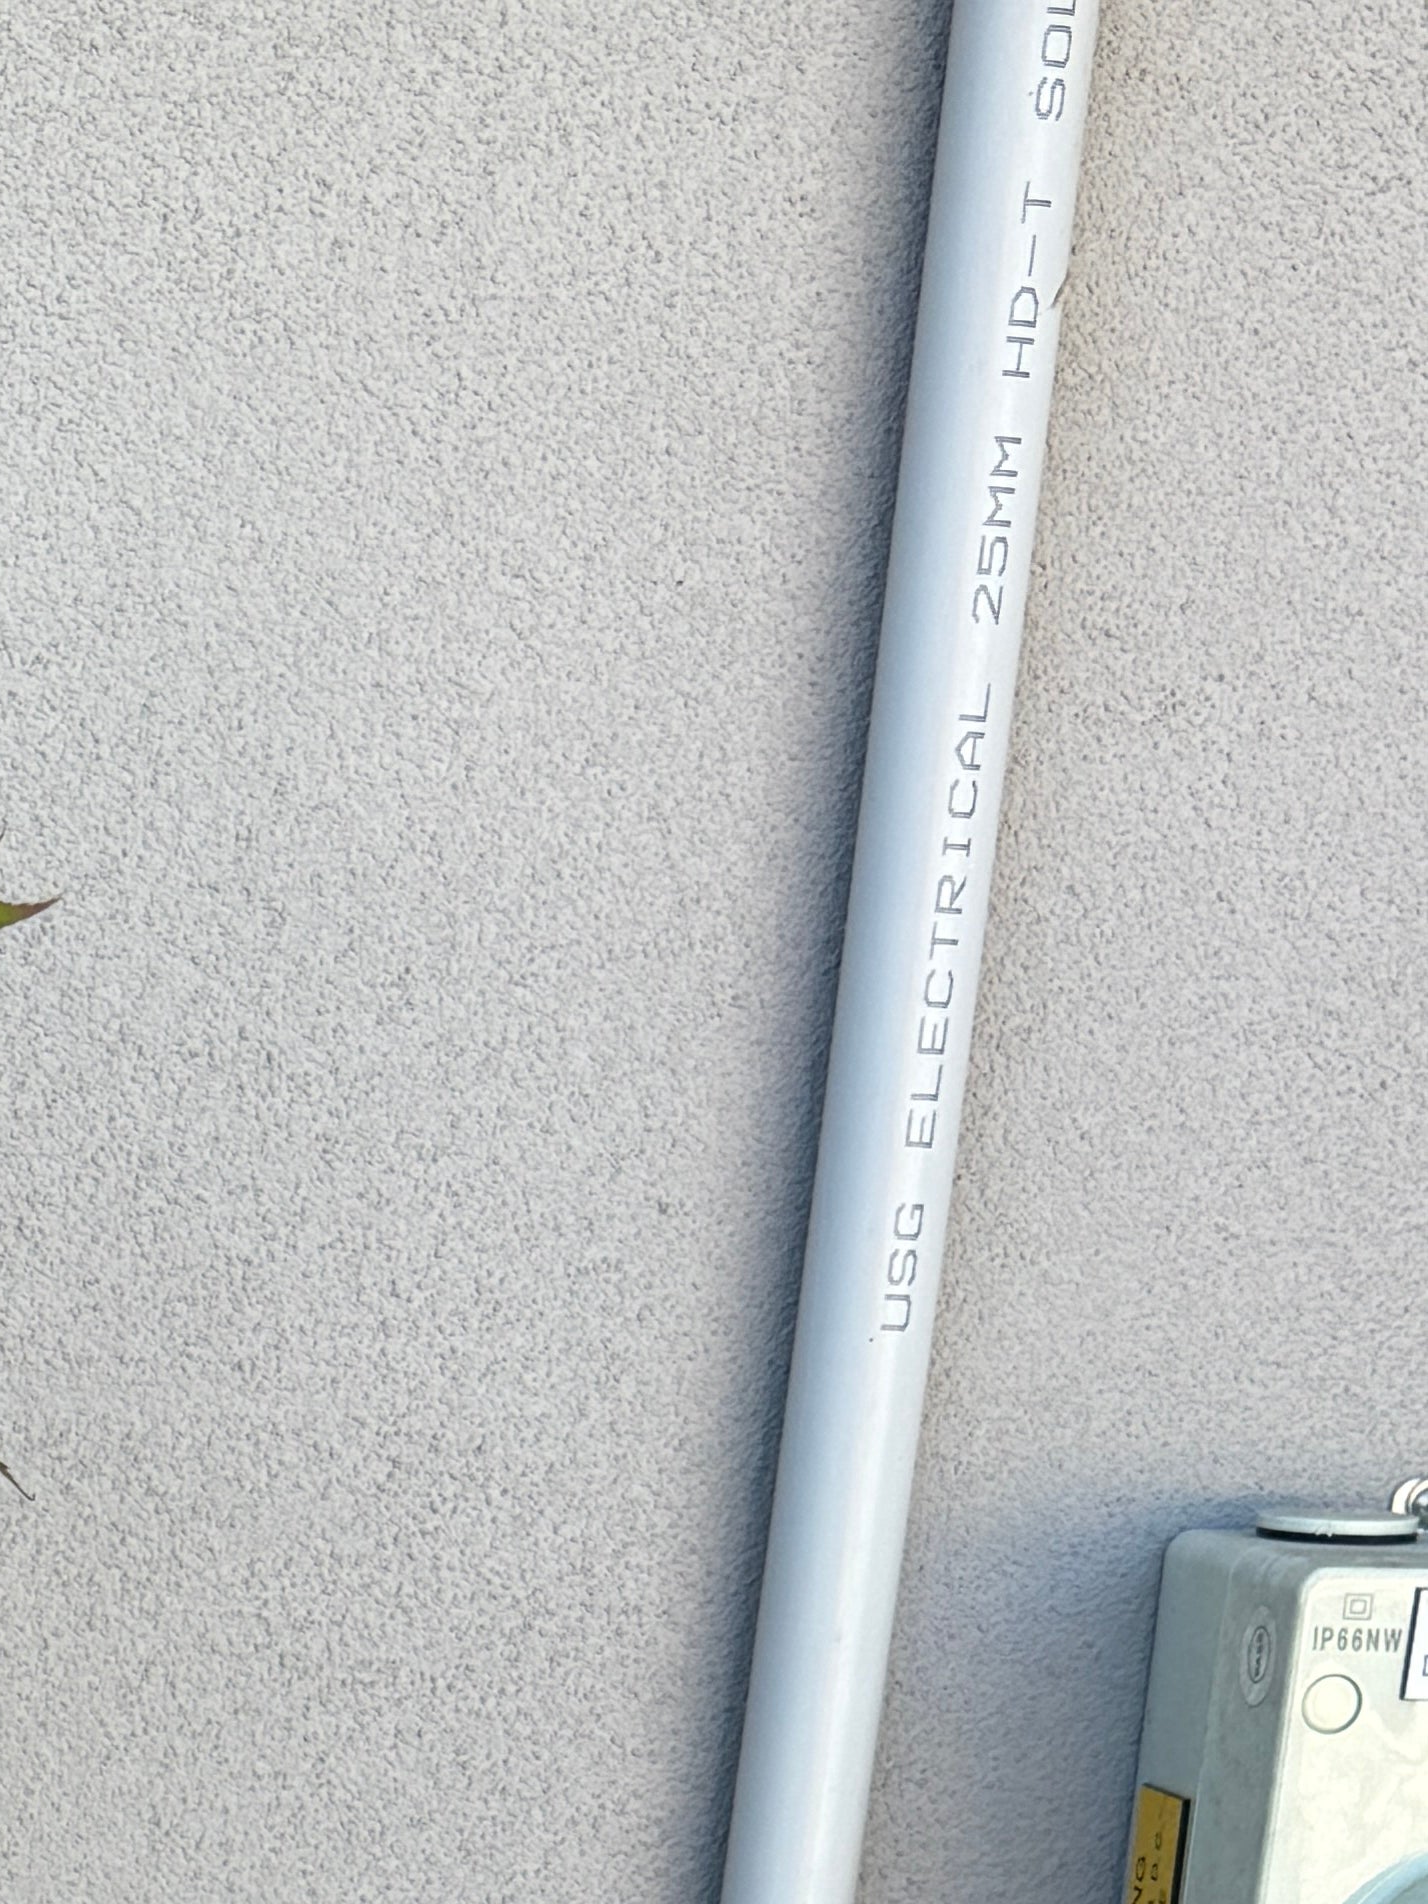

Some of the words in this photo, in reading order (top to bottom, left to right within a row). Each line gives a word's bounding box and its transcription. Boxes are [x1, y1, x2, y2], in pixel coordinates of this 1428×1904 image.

[879, 1201, 925, 1334] USG
[905, 682, 993, 1150] ELECTRICAL
[972, 434, 1021, 627] 25MM
[1002, 181, 1052, 379] HD-T
[1312, 1625, 1404, 1653] IP66NW
